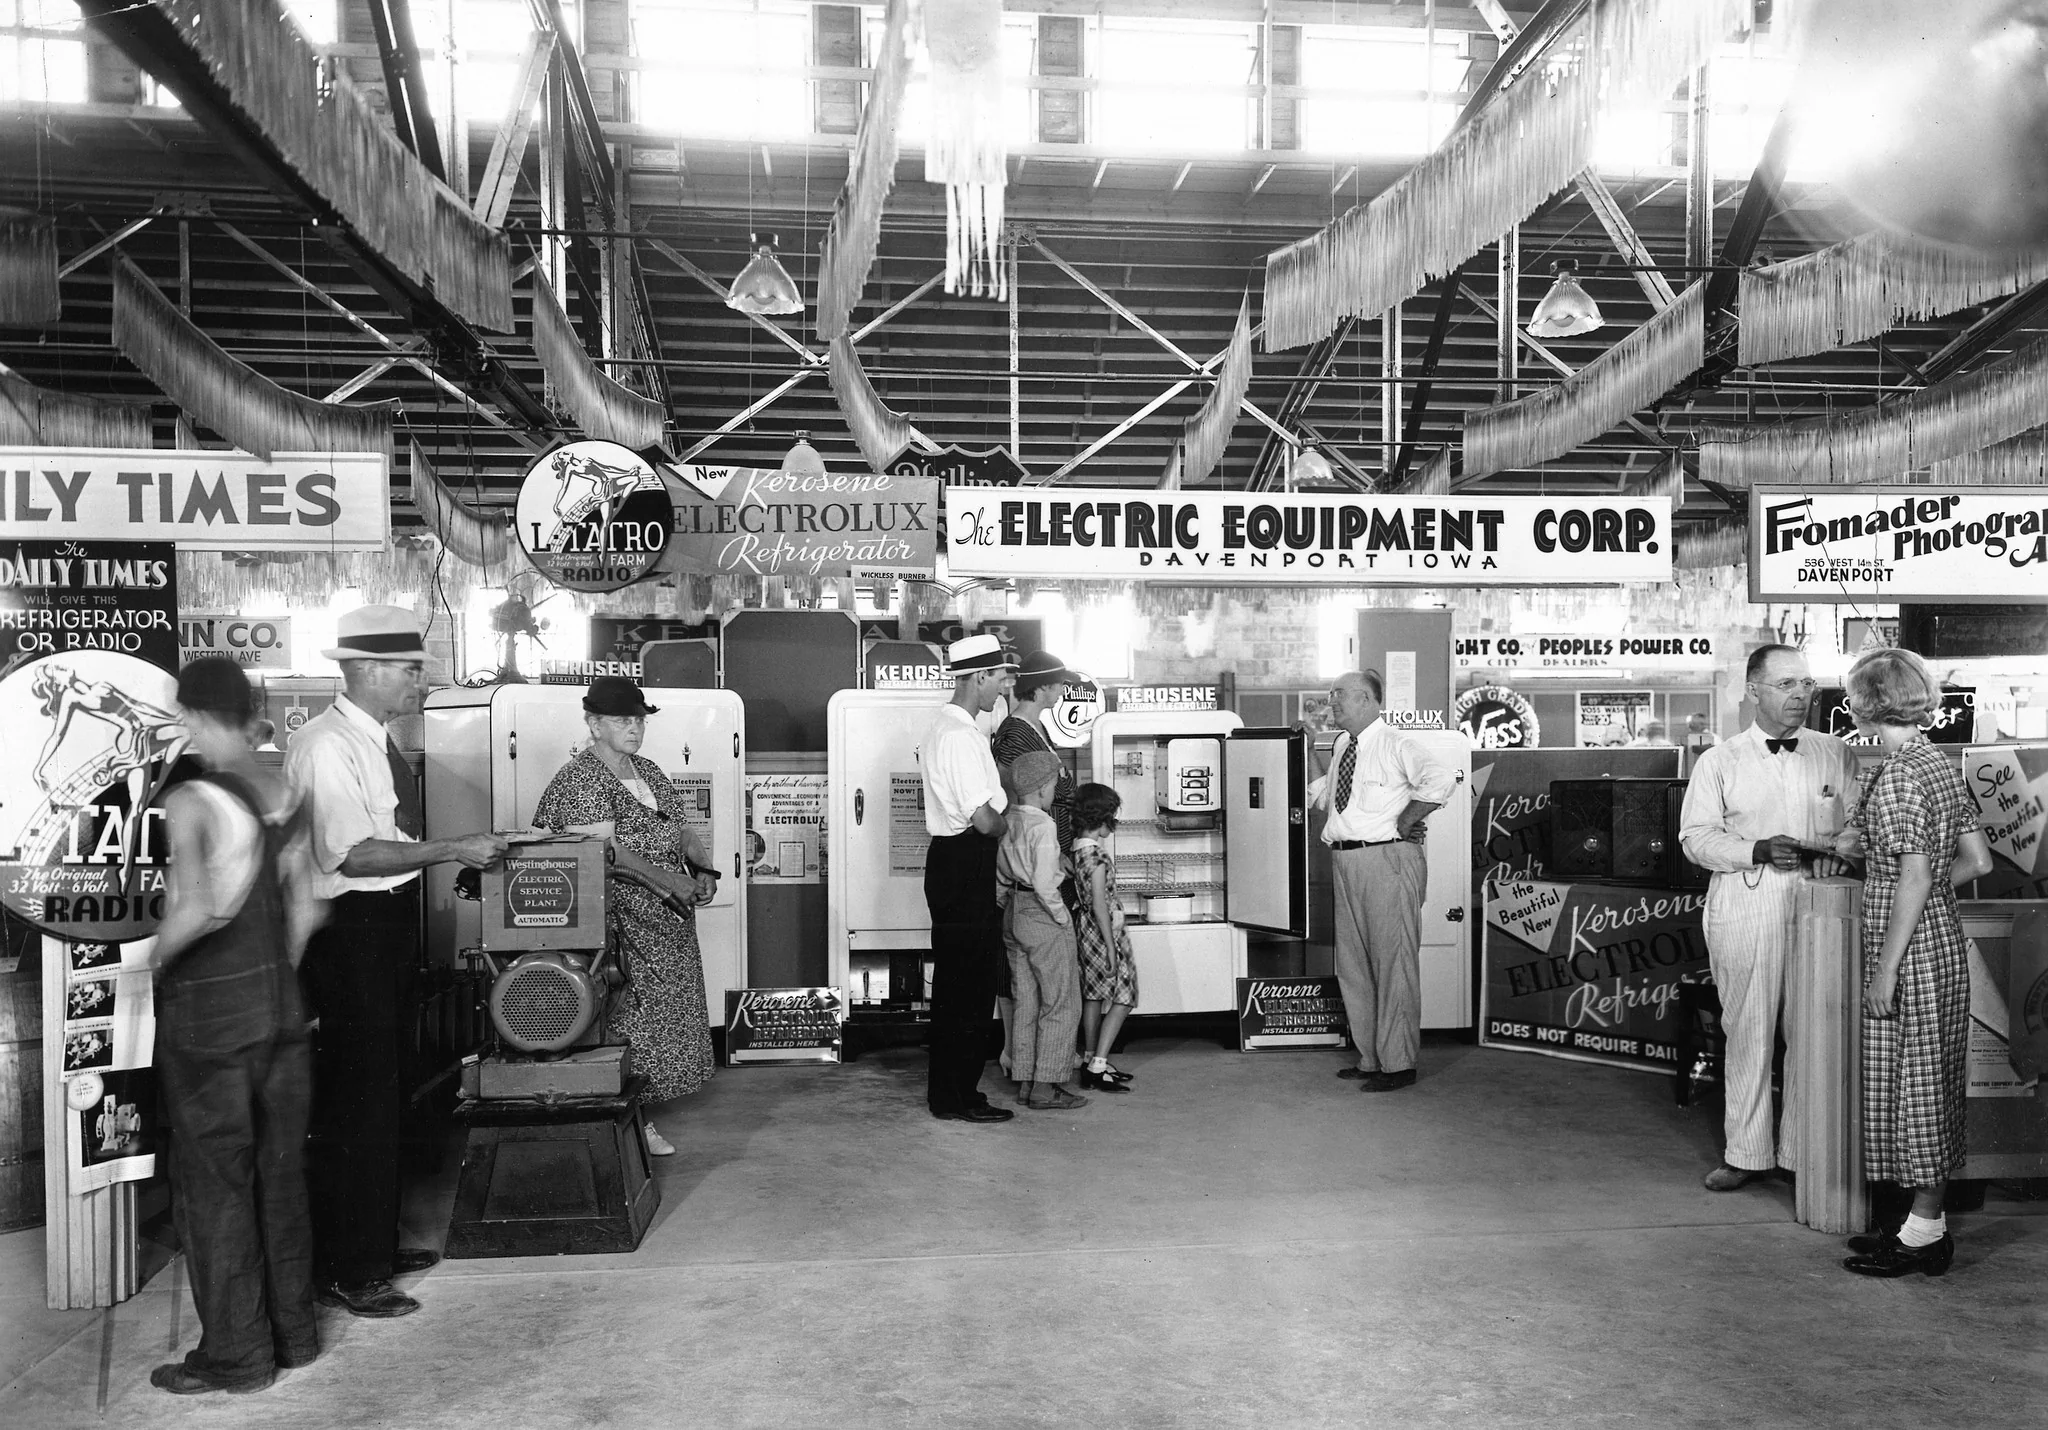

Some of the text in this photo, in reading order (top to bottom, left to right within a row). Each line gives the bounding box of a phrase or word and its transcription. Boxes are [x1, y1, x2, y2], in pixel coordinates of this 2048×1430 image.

[695, 466, 729, 481] New
[116, 469, 341, 527] TIMES
[737, 469, 894, 513] Kerosene
[670, 502, 929, 534] ELECTROLUX
[1766, 495, 1960, 555] Fromader
[955, 501, 1659, 554] The ELECTRIC EQUIPMENT CORP.
[55, 541, 88, 557] The
[718, 533, 916, 576] Refrigerator
[610, 554, 646, 566] FARM
[1139, 552, 1498, 570] DAVENPORT IOWA
[1804, 558, 1825, 567] 536
[1830, 558, 1853, 567] WEST
[0, 548, 168, 590] DAILY TIMES
[563, 567, 631, 582] RADIO
[1798, 568, 1894, 582] DAVENPORT
[24, 595, 117, 605] WILL GIVE THIS
[0, 608, 172, 631] REFRIGERATOR
[17, 631, 142, 651] OR RADIO
[227, 622, 283, 649] CO.
[614, 643, 638, 651] THE
[1497, 638, 1524, 656] CO.
[1539, 638, 1614, 656] PEOPLES
[1620, 639, 1684, 655] POWER
[1689, 638, 1713, 656] CO.
[239, 650, 262, 662] AVE
[1543, 658, 1608, 666] DEALERS
[541, 659, 641, 676] KEROSENE
[874, 665, 955, 681] KEROSE
[916, 680, 955, 689] ELECTRO
[1063, 684, 1096, 702] Phillips
[1117, 687, 1216, 703] KEROSENE
[1487, 689, 1529, 723] GRADE
[1381, 710, 1444, 724] TROLUX
[1977, 763, 2015, 799] See
[1998, 792, 2020, 812] the
[764, 815, 825, 825] ELECTROLUX
[1984, 795, 2045, 845] Beautiful
[2010, 831, 2037, 856] New
[506, 859, 577, 871] Westinghouse
[21, 868, 107, 882] The Original
[140, 869, 167, 892] FA
[518, 875, 564, 883] ELECTRIC
[8, 880, 26, 894] 32
[519, 887, 562, 896] SERVICE
[1512, 882, 1535, 900] the
[524, 899, 558, 907] PLANT
[1498, 888, 1560, 926] Beautiful
[517, 916, 565, 924] AUTOMATIC
[1522, 917, 1552, 936] New
[1504, 927, 1710, 998] ELECTROL
[1241, 981, 1322, 1019] Kerosene
[729, 991, 818, 1033] Kerosene
[753, 1026, 840, 1040] REFRIGERATOR
[1306, 1026, 1329, 1034] HERE
[1491, 1021, 1530, 1038] DOES
[1537, 1028, 1568, 1044] NOT
[1574, 1032, 1638, 1055] REQUIRE
[749, 1040, 794, 1048] INSTALLED
